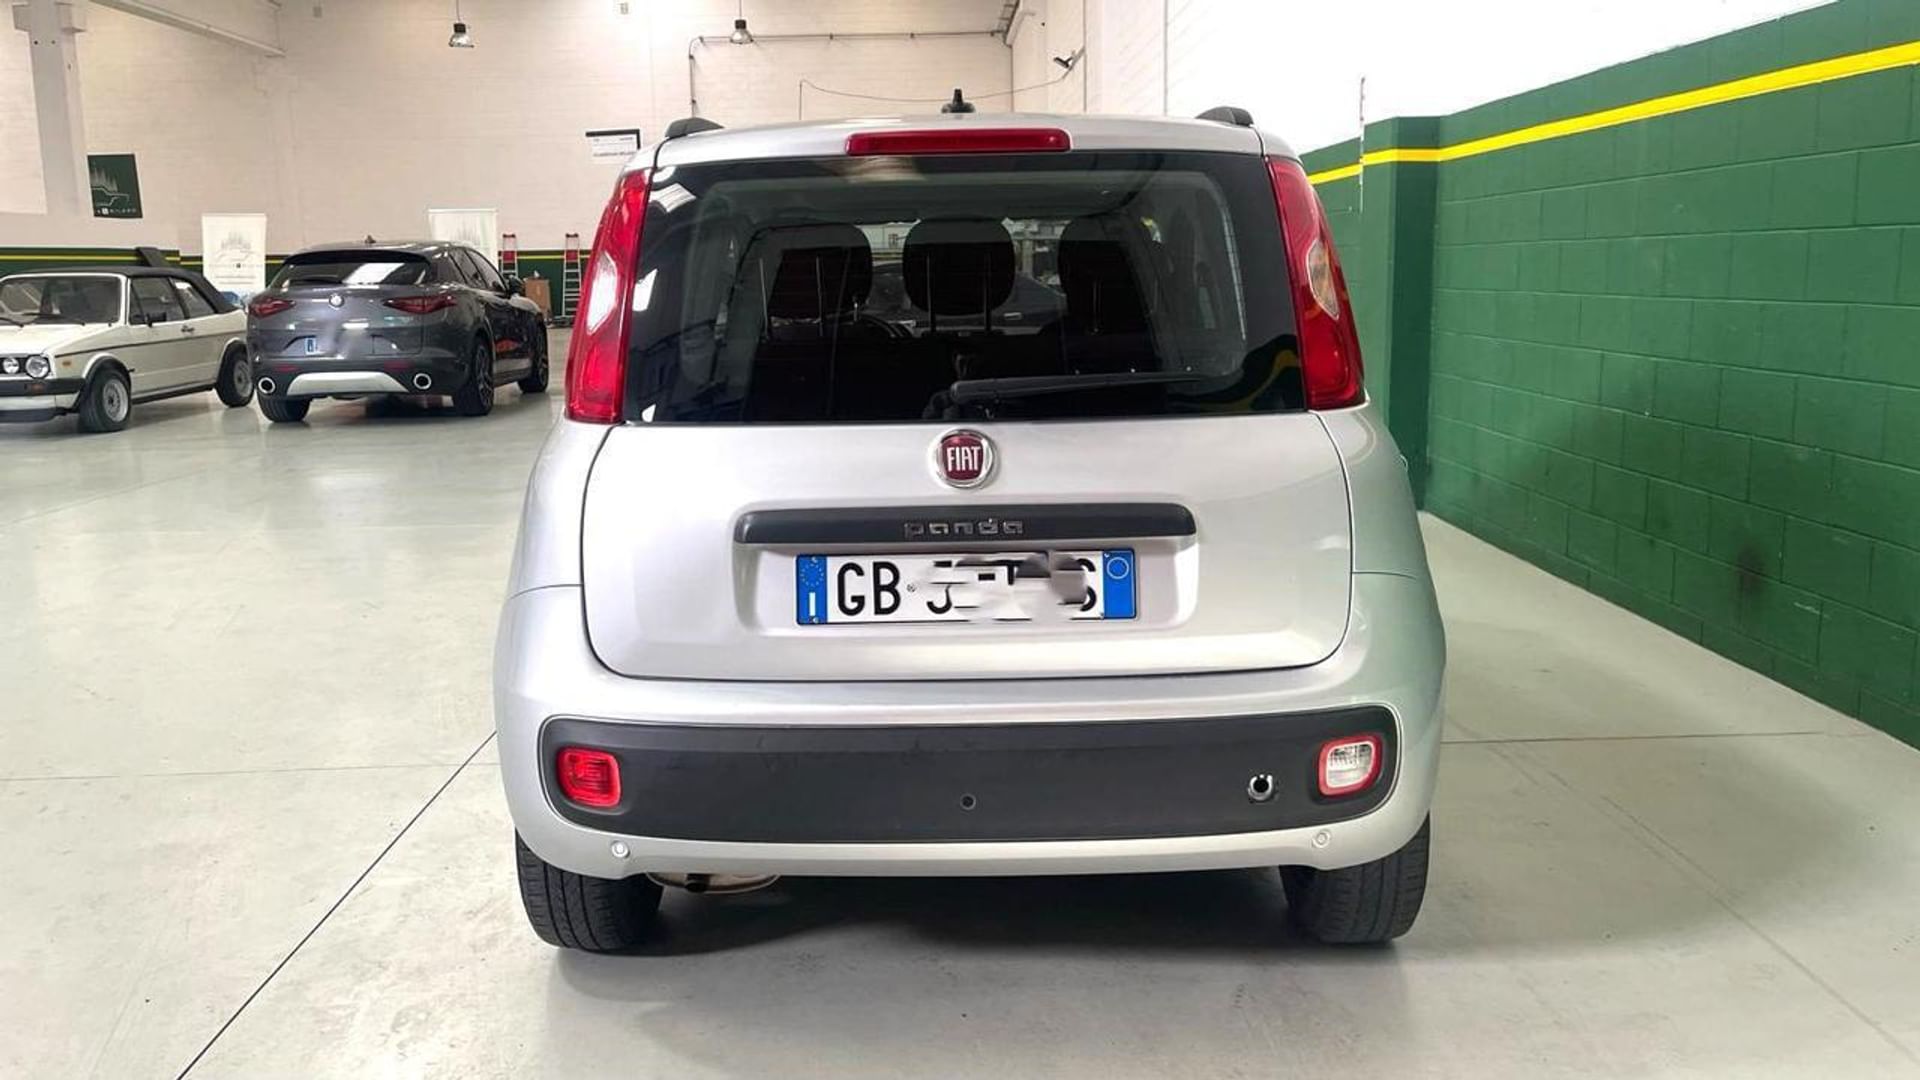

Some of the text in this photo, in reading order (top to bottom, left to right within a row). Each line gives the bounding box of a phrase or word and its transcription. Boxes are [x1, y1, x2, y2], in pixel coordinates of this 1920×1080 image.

[946, 446, 982, 473] FIAT
[904, 518, 1024, 538] panda
[837, 561, 901, 616] GB
